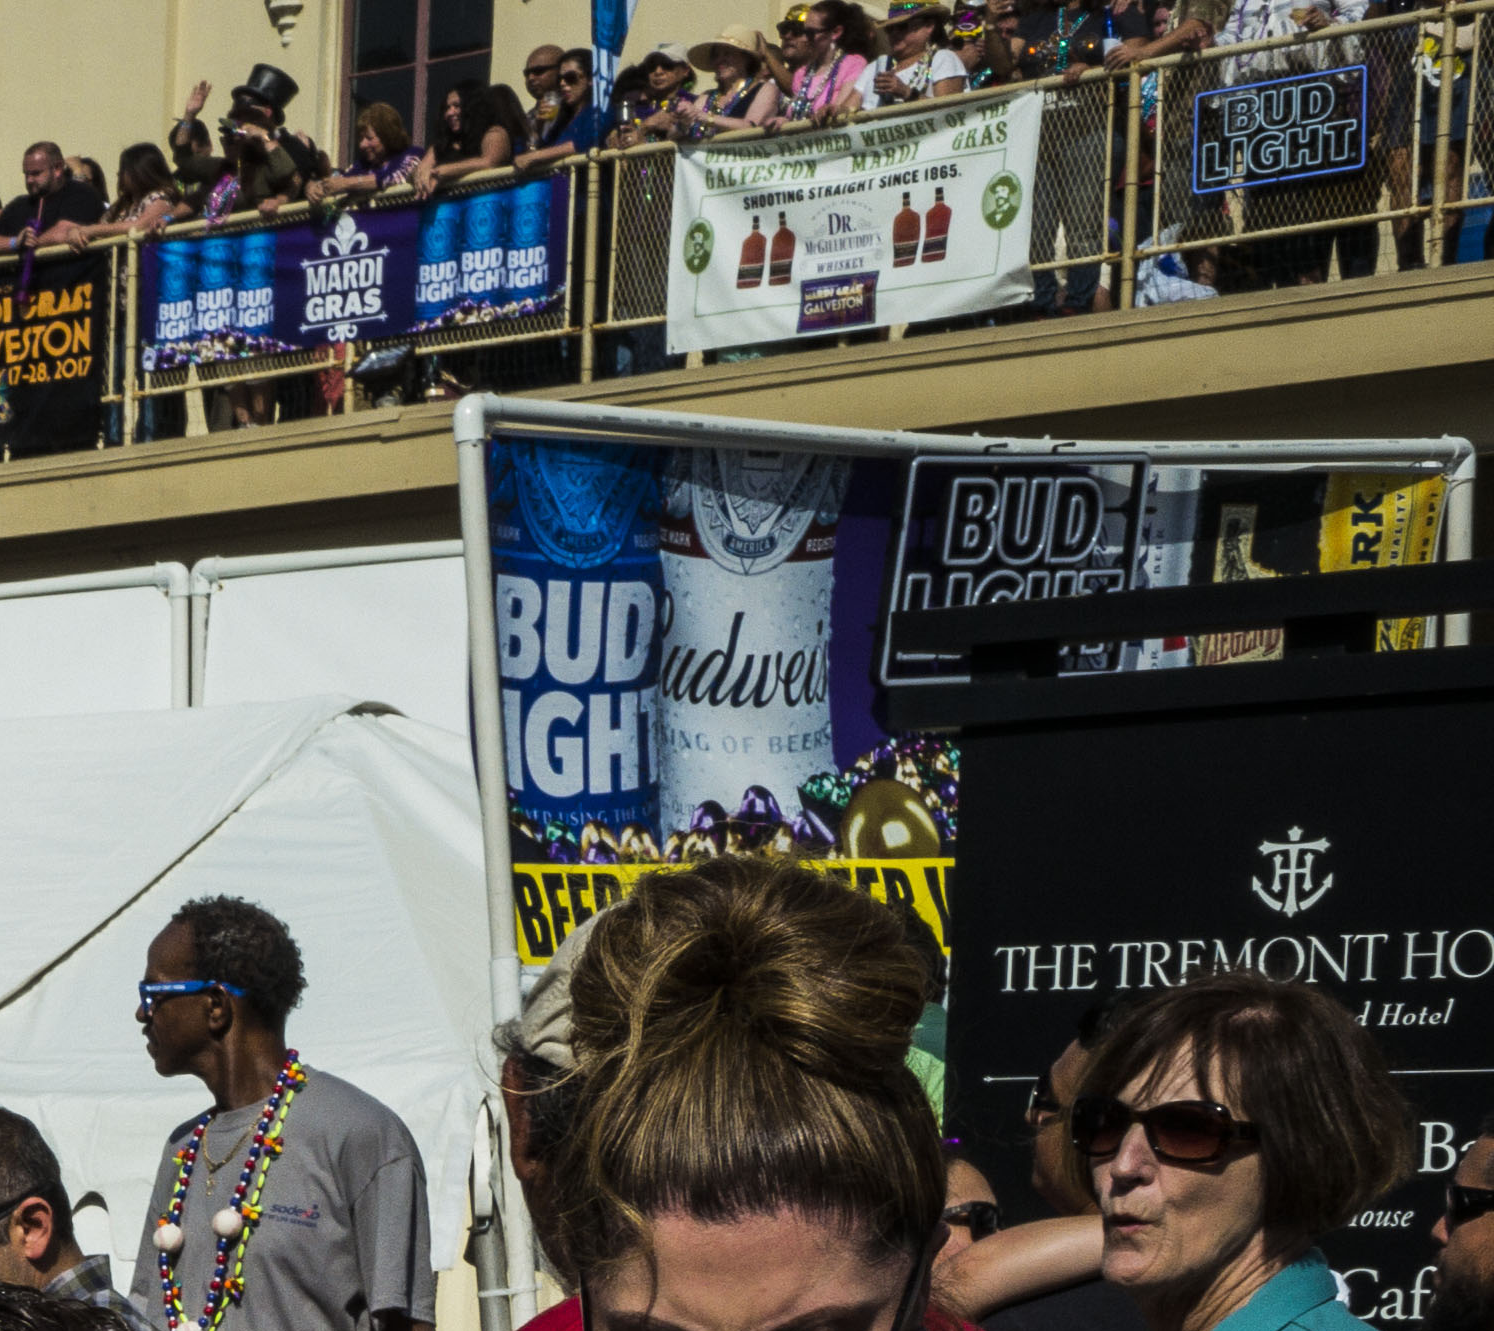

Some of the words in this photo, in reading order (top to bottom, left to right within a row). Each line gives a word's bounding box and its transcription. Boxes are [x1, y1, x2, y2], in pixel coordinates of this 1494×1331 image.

[860, 117, 937, 147] WHISKEY
[945, 111, 967, 128] OF
[976, 100, 1011, 121] THE
[1224, 82, 1335, 136] BUD
[705, 159, 817, 190] GALVESTON
[851, 141, 922, 173] MARDI
[952, 120, 1008, 151] GRAS
[1202, 119, 1357, 182] LIGHT
[743, 188, 804, 211] SHOOTING
[808, 177, 875, 200] STRAIGHT
[879, 168, 920, 189] SINCE
[924, 163, 962, 183] 1865.
[828, 212, 857, 235] DR.
[419, 260, 457, 284] BUD
[461, 247, 504, 273] BUD
[507, 245, 547, 270] BUD
[817, 256, 865, 273] WHISKEY
[306, 255, 384, 296] MARDI
[158, 300, 193, 321] BUD
[196, 287, 233, 311] BUD
[237, 287, 273, 309] BUD
[305, 288, 382, 323] GRAS
[803, 295, 864, 316] GALVESTON
[54, 356, 92, 379] 2017
[942, 475, 1105, 566] BUD
[1351, 492, 1383, 565] RK
[728, 535, 772, 553] AMERICA
[496, 574, 657, 685] BUD
[502, 687, 659, 799] IGHT
[722, 735, 755, 754] OF
[768, 720, 833, 754] BEERS
[994, 943, 1098, 992] THE
[1108, 933, 1389, 990] TREMONT
[1403, 928, 1494, 982] HO
[1378, 998, 1455, 1027] Hotel
[270, 1203, 320, 1220] sodexo
[1348, 1209, 1414, 1228] ouse
[1343, 1266, 1438, 1321] Caf
